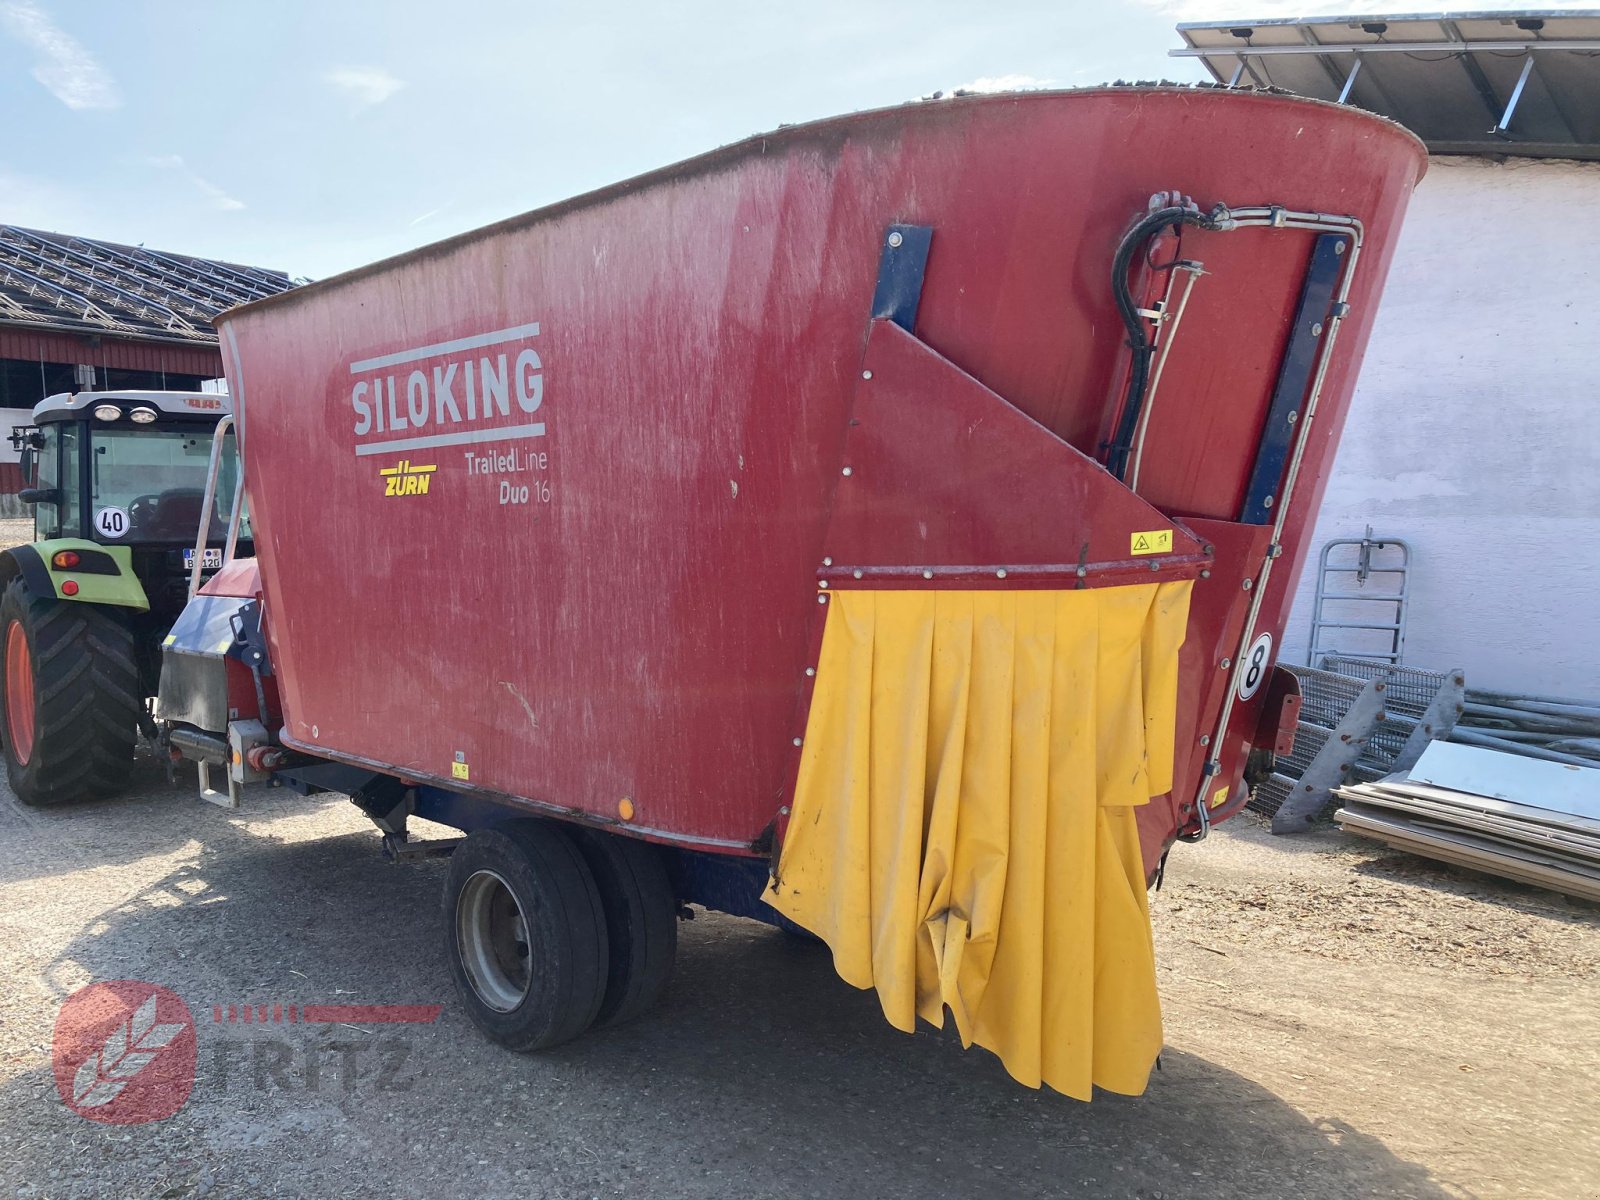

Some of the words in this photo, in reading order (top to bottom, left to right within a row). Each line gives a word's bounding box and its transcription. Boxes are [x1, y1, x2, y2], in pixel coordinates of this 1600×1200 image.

[352, 348, 543, 435] SILOKING
[464, 447, 548, 475] TrailedLine
[499, 481, 529, 504] Duo
[534, 480, 551, 503] 16
[102, 512, 123, 532] 40
[1245, 645, 1265, 689] 8
